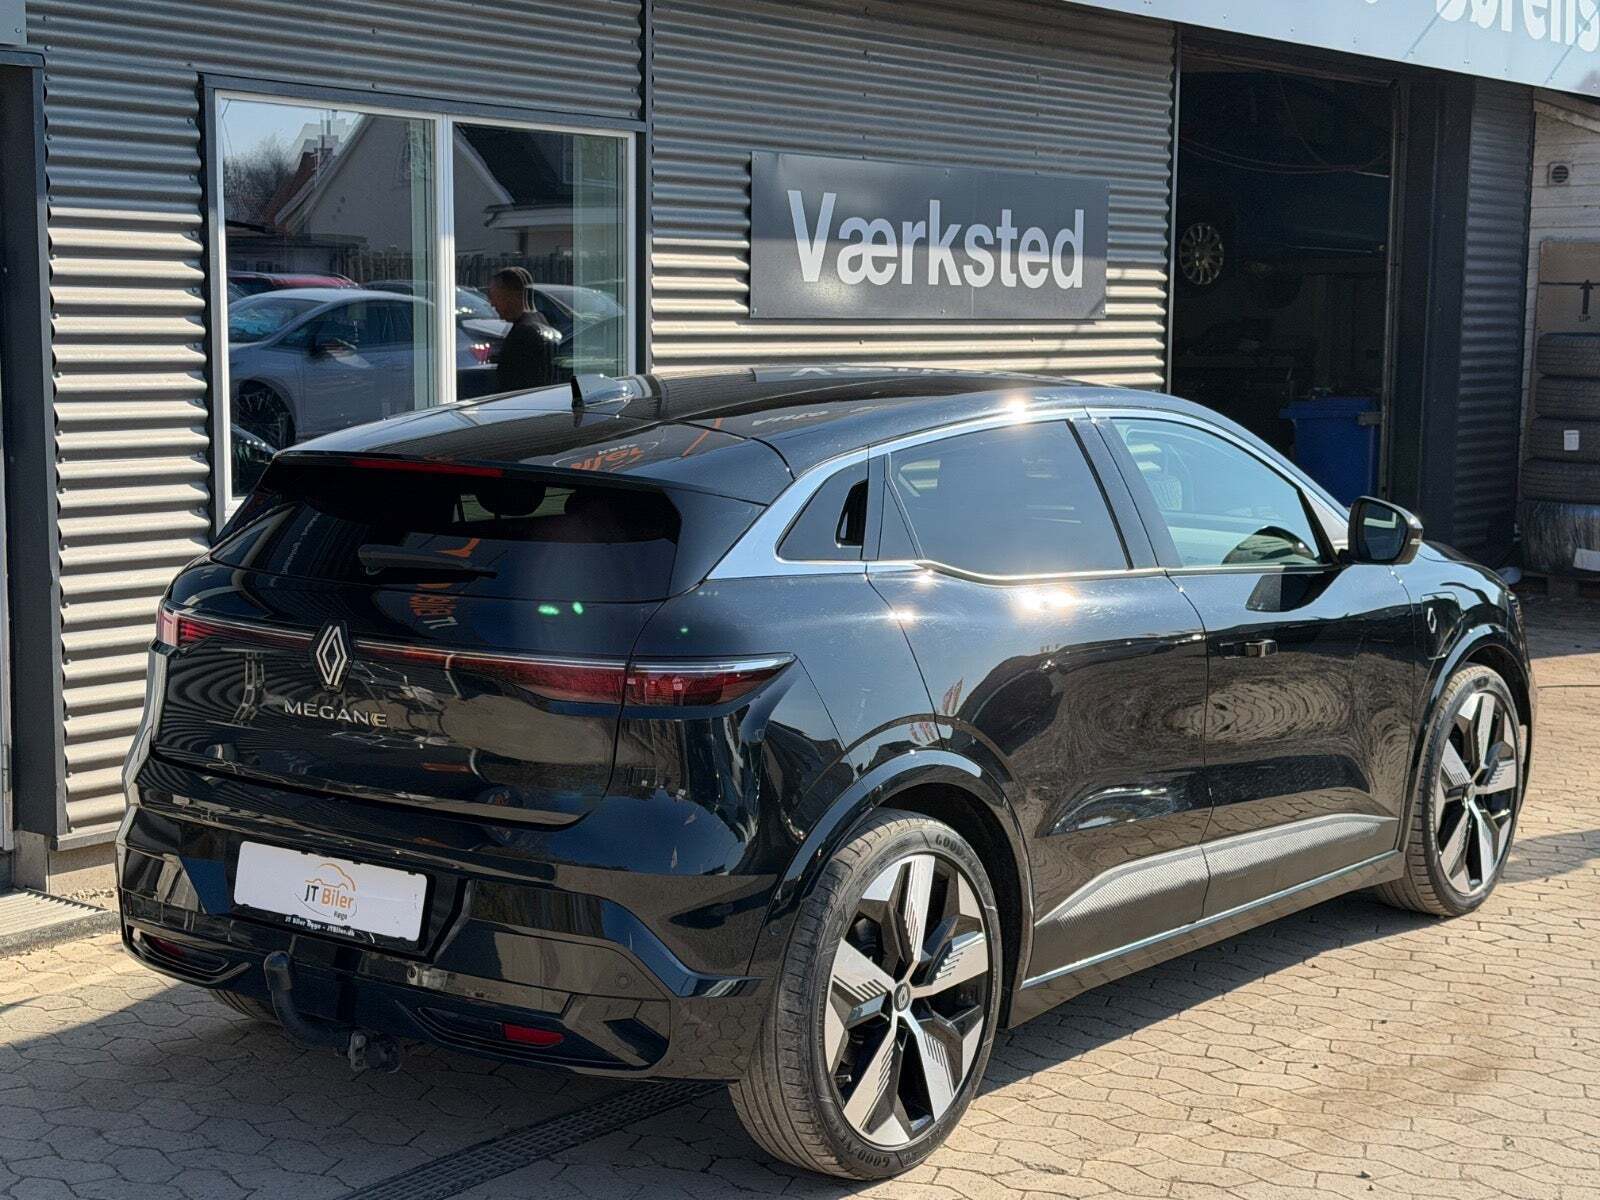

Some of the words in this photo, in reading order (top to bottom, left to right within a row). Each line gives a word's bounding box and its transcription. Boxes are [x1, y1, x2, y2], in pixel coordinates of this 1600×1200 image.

[787, 189, 1085, 290] Værksted
[284, 699, 388, 728] MEGANE
[304, 884, 319, 902] JT
[322, 887, 354, 909] Biler
